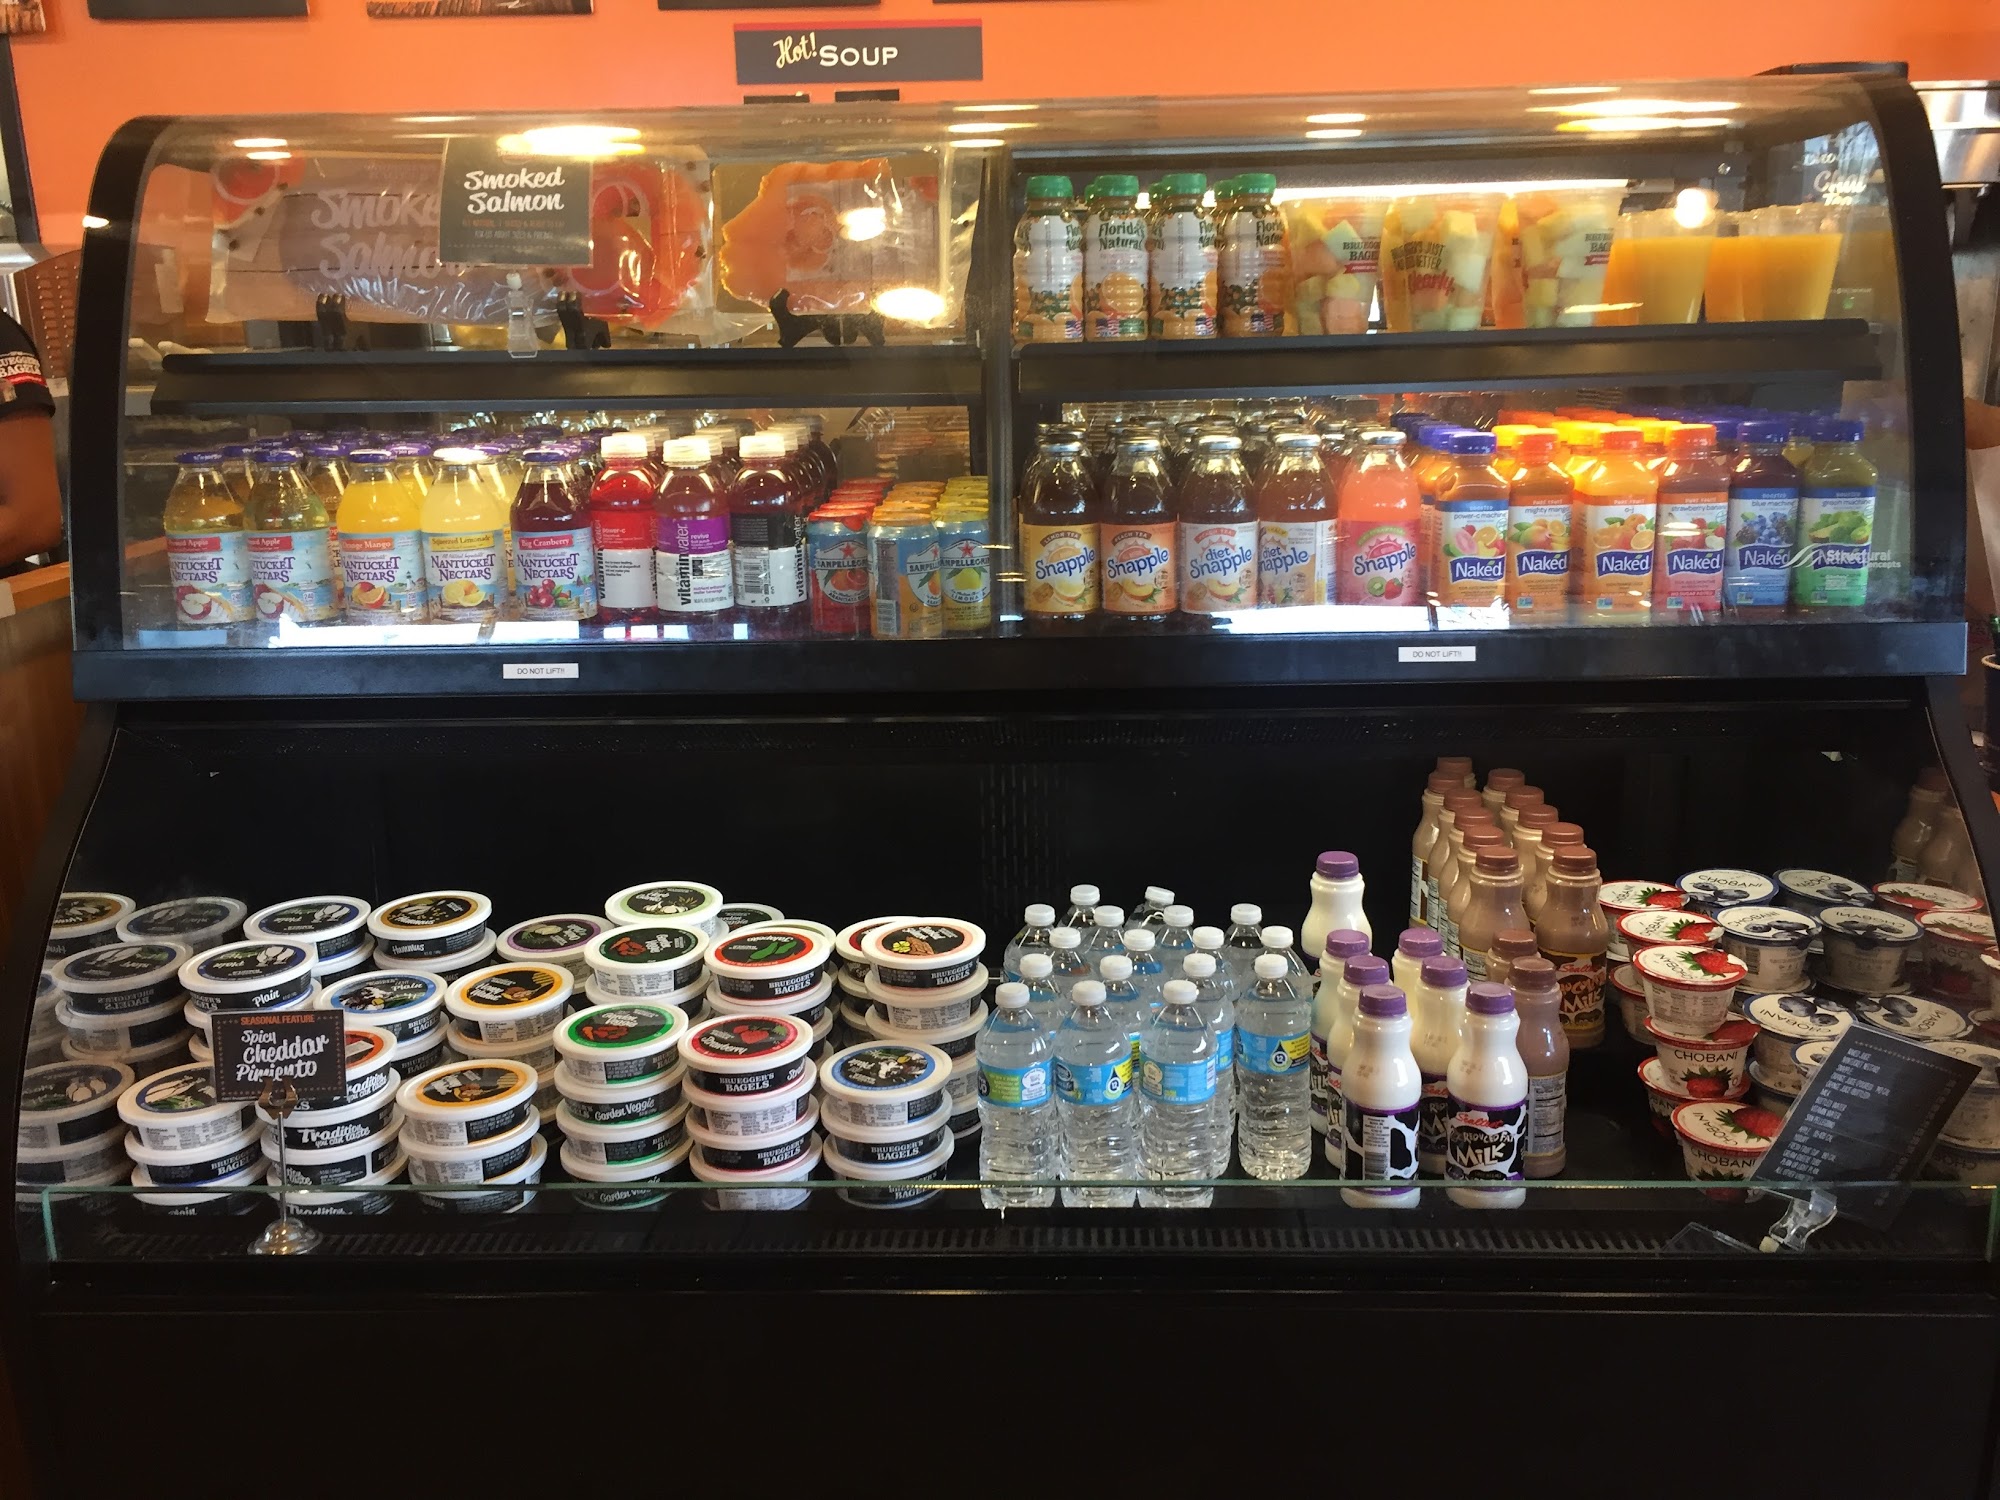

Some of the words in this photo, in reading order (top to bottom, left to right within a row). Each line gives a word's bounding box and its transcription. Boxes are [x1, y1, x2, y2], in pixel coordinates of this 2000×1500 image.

[773, 32, 817, 69] Hot!
[819, 45, 898, 67] SOUP
[463, 166, 565, 191] Smoked
[311, 189, 440, 230] Smoke
[467, 192, 565, 215] Salmon
[1099, 220, 1144, 238] Florida's
[1099, 237, 1143, 251] Natural
[1525, 507, 1548, 515] mighty
[460, 535, 491, 545] Lemonade
[521, 540, 532, 549] Big
[533, 538, 570, 547] Cranberry
[1042, 532, 1065, 545] LEMON
[1066, 531, 1080, 540] TEA
[1134, 531, 1149, 539] TEA
[364, 540, 391, 549] Mango
[342, 556, 401, 571] NANTUCKET
[431, 553, 496, 569] NANTUCKET
[517, 553, 579, 569] NANTUCKET
[1035, 547, 1095, 579] Snapple
[1107, 547, 1169, 579] Snapple
[1190, 547, 1252, 579] Snapple
[1206, 549, 1231, 561] diet
[1258, 547, 1309, 575] napple
[1354, 542, 1416, 576] Snapple
[1522, 553, 1567, 572] Naked
[1602, 554, 1650, 572] Naked
[1672, 554, 1720, 570] Naked
[1744, 550, 1791, 566] Naked
[1455, 561, 1503, 577] Naked
[1866, 561, 1902, 569] oncepts
[347, 569, 396, 583] NECTARS
[439, 567, 492, 582] NECTARS
[523, 567, 576, 581] NECTARS
[951, 593, 986, 603] LIMONAA
[1698, 874, 1763, 888] CHOBANI
[1727, 910, 1781, 928] CHOBANI
[931, 961, 973, 979] BRUEGGER'S
[1654, 952, 1695, 980] CHOBANI
[768, 971, 814, 989] BRUEGGER'S
[936, 970, 970, 986] BAGELS
[774, 979, 811, 996] BAGELS
[252, 990, 281, 1008] Plain
[240, 1015, 282, 1026] SEASONAL
[282, 1014, 316, 1024] FEATURE
[1759, 1008, 1833, 1033] CHOBANI
[241, 1029, 276, 1046] Spicy
[701, 1035, 748, 1056] Strawberry
[243, 1034, 329, 1065] Cheddar
[1674, 1049, 1738, 1063] CHOBANI
[1275, 1055, 1284, 1063] 12
[236, 1060, 318, 1083] Pimiento
[719, 1073, 775, 1085] BRUEGGER'S
[346, 1072, 385, 1096] raditio
[725, 1080, 770, 1092] BAGELS
[595, 1107, 626, 1122] Garden
[625, 1098, 655, 1114] Veggie
[297, 1124, 362, 1144] Tradition
[315, 1141, 328, 1149] you
[329, 1136, 344, 1146] can
[345, 1125, 371, 1143] taste
[1692, 1111, 1738, 1146] CHOBANI
[757, 1137, 805, 1159] BRUEGGER'S
[870, 1139, 924, 1154] BRUEGGER'S
[877, 1147, 920, 1161] BAGELS
[763, 1148, 800, 1166] BAGELS
[1690, 1146, 1756, 1168] CHOBANI
[600, 1190, 631, 1203] Garden
